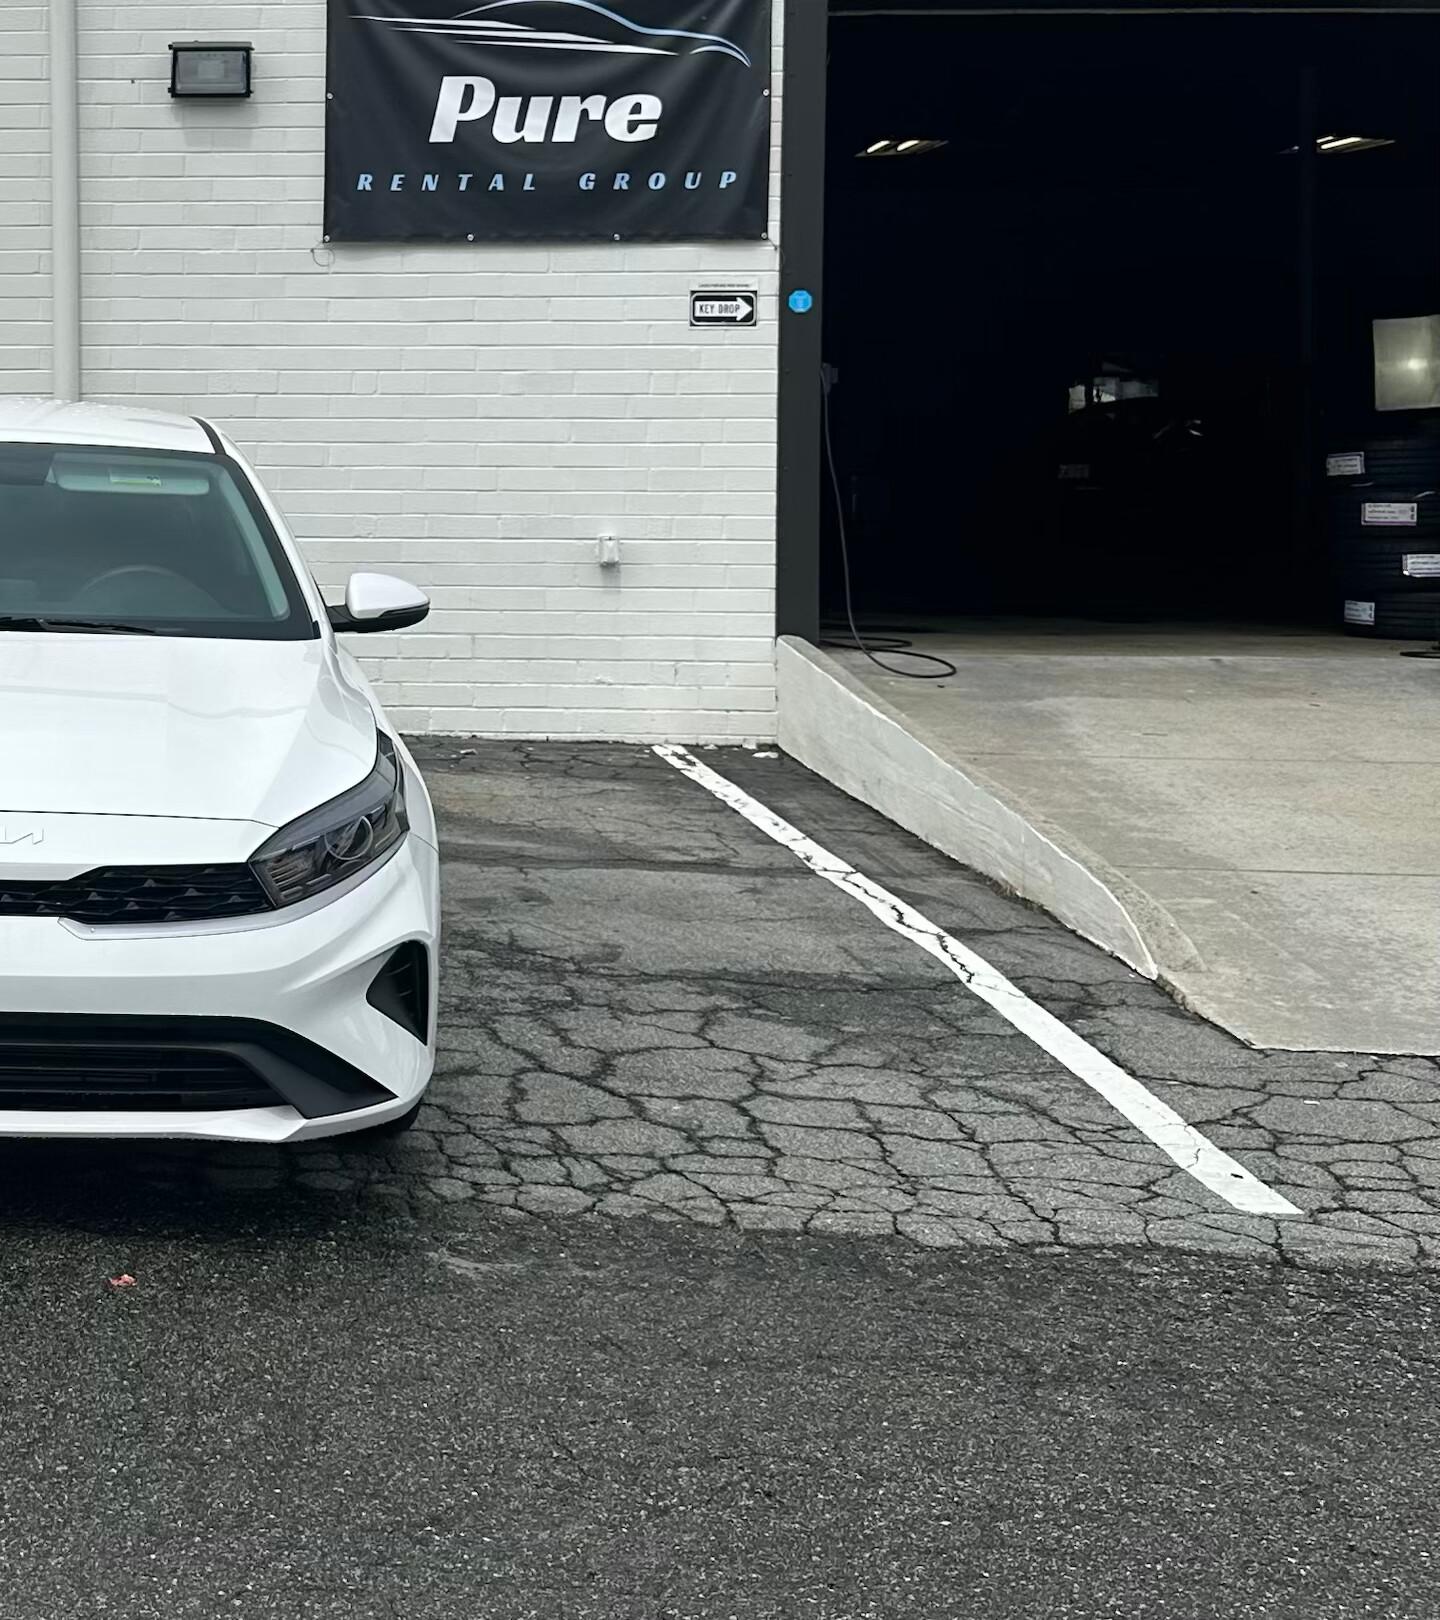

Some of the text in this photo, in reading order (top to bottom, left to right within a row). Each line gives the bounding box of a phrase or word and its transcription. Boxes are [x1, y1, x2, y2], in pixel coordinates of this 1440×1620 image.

[428, 75, 663, 143] Pure
[356, 170, 738, 192] RENTAL GROUP
[699, 303, 740, 314] KEY DROP
